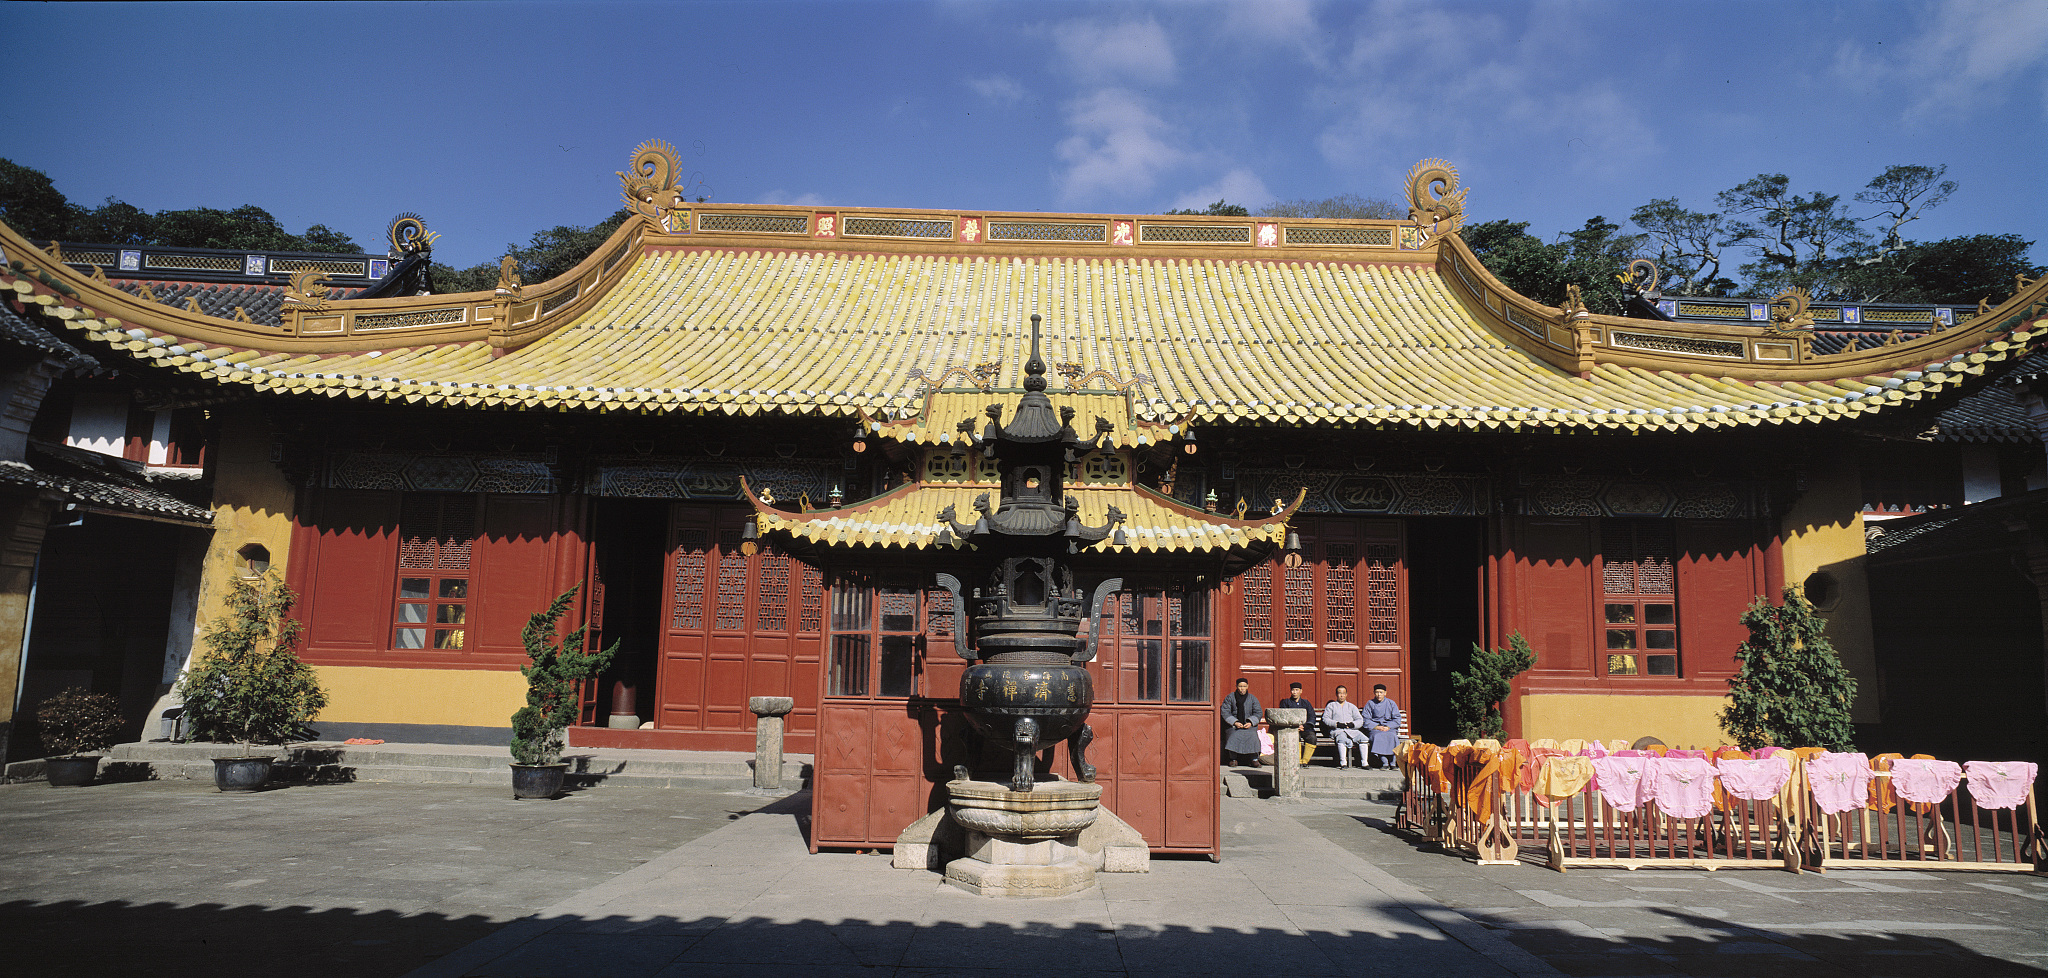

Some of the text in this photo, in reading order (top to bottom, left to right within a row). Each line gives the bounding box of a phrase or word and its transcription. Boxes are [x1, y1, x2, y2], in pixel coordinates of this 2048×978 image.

[814, 217, 1277, 246] 佛 光 普 照
